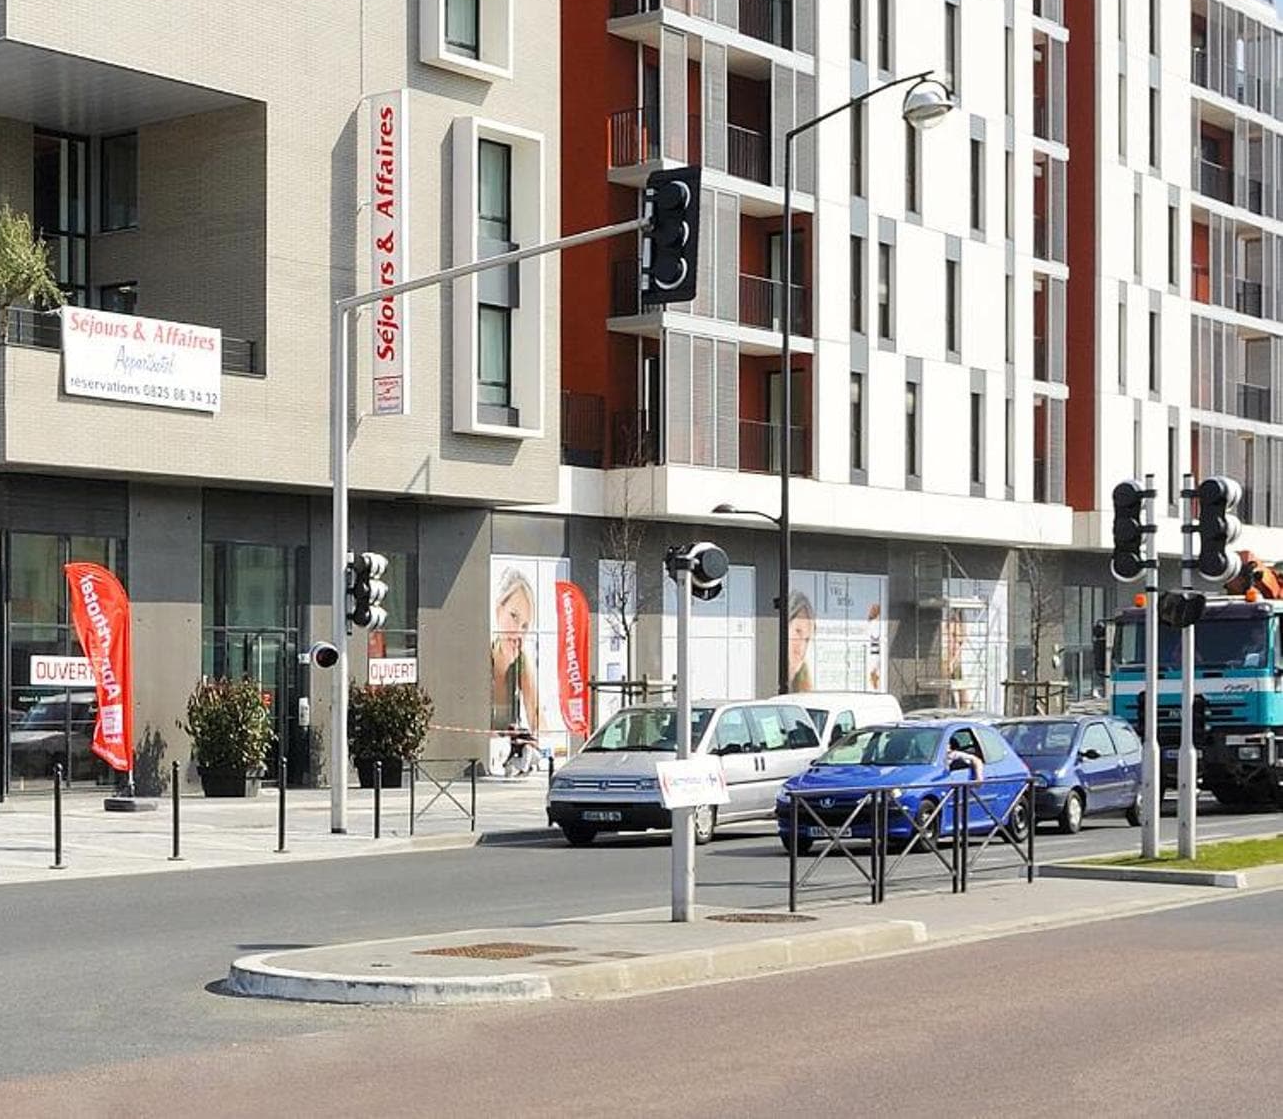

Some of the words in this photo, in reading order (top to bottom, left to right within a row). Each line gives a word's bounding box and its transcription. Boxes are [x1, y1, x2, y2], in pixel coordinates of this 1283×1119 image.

[376, 105, 394, 218] Affaires
[376, 230, 394, 254] &
[133, 321, 146, 341] &
[154, 325, 215, 351] Affaires
[370, 663, 415, 679] OUVERT
